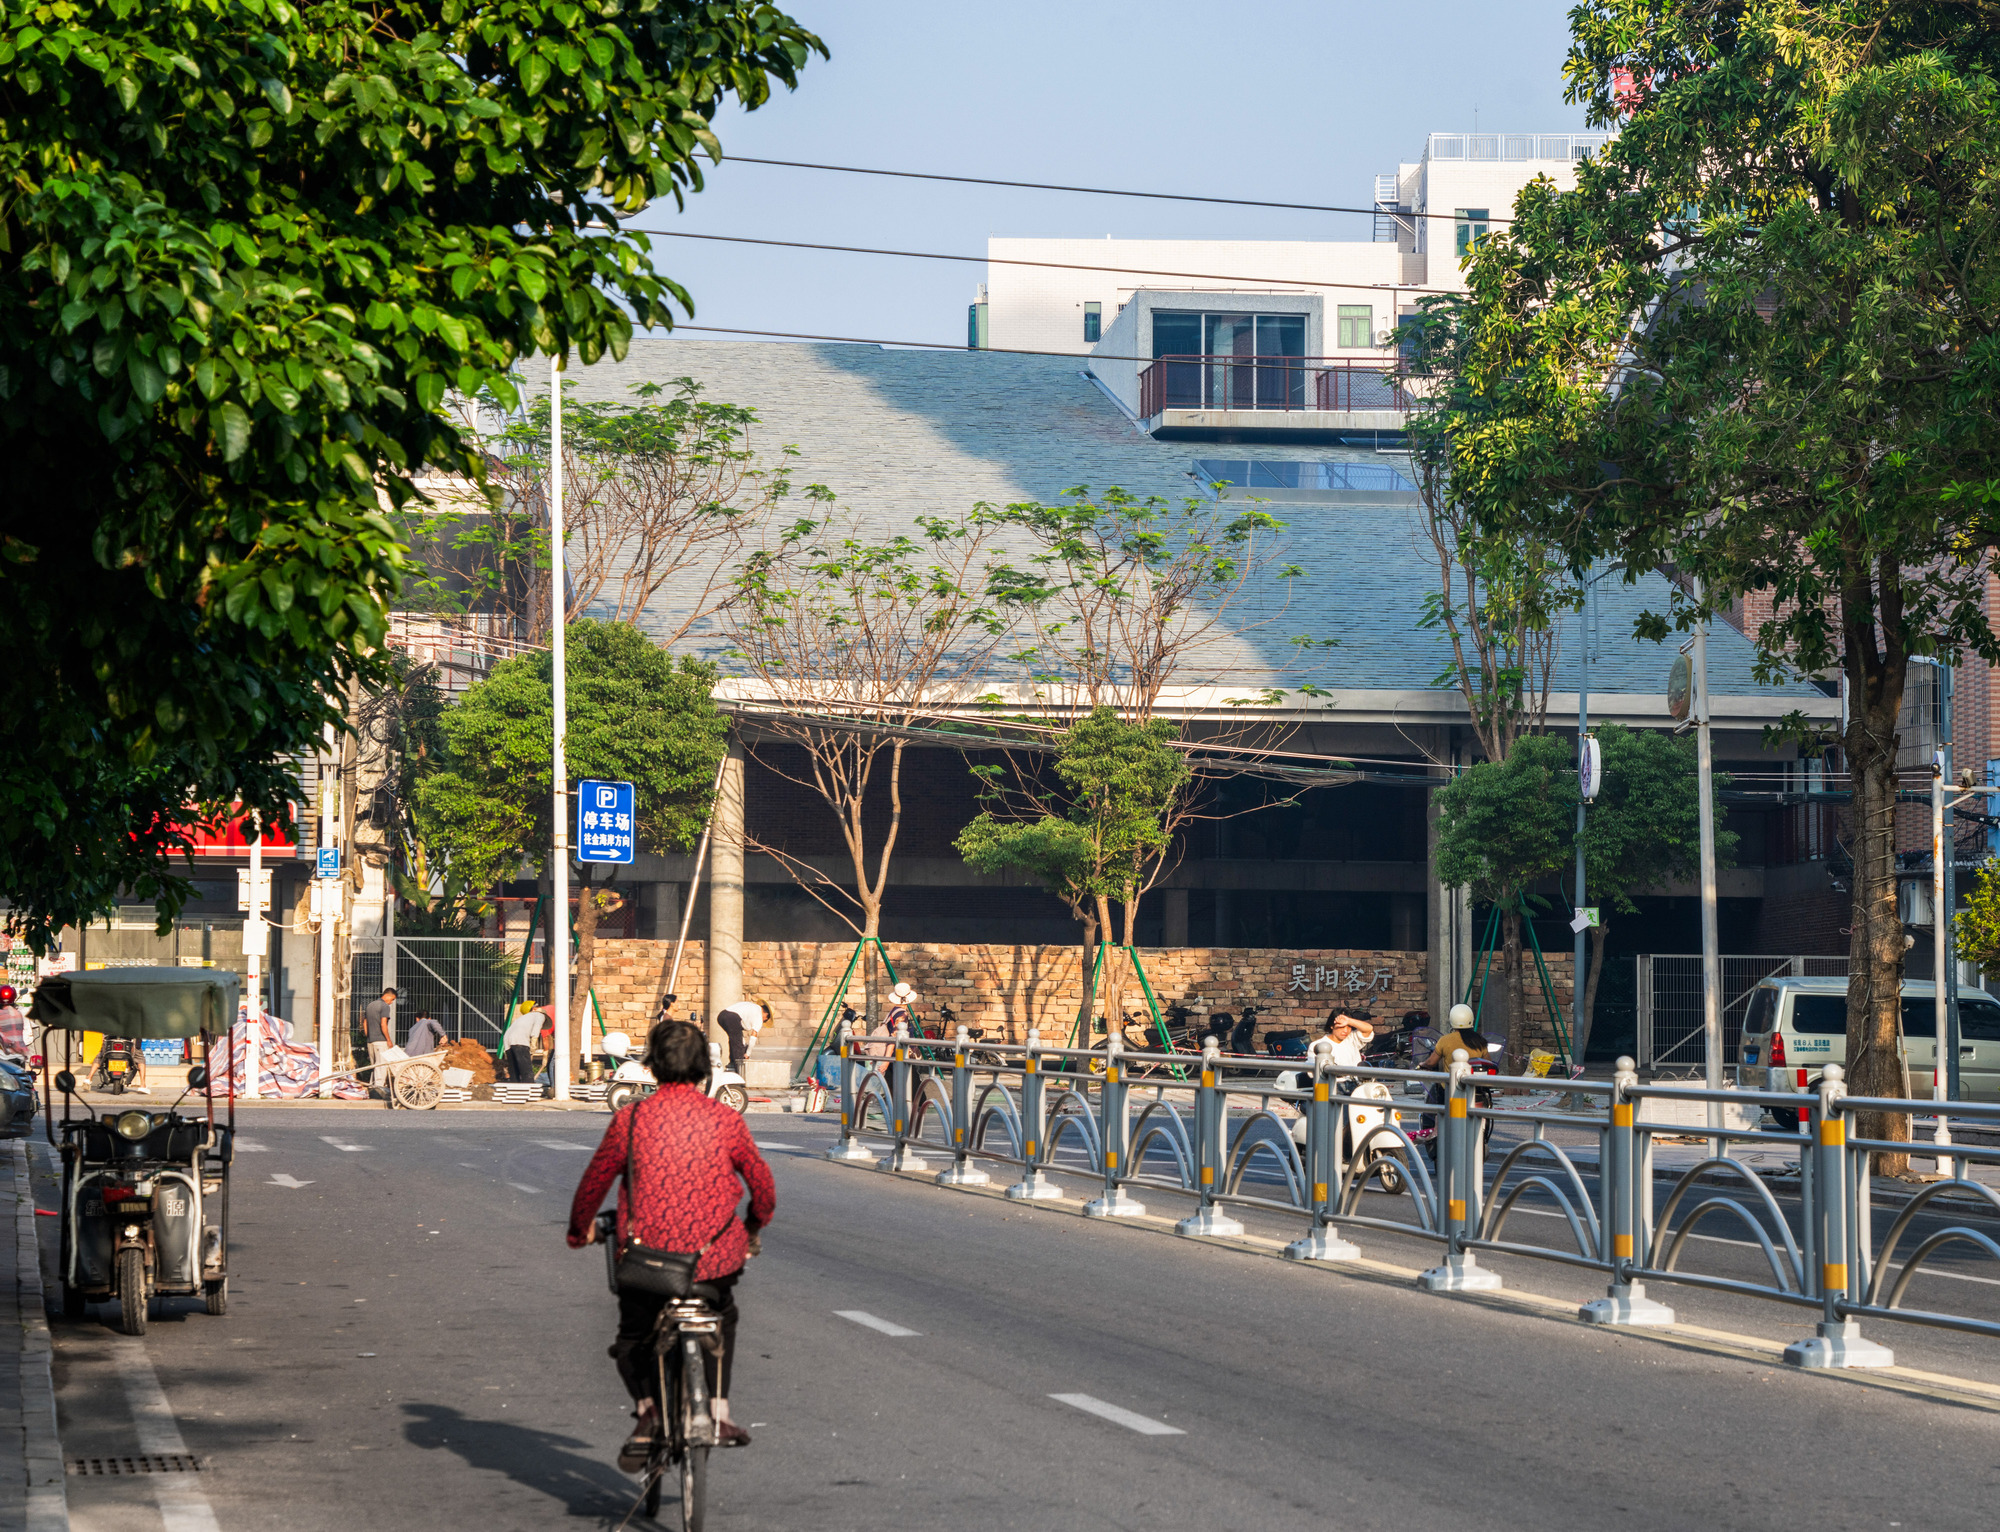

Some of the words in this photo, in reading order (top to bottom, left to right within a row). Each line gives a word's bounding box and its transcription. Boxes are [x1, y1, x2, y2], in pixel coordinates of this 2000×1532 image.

[601, 790, 614, 806] P
[583, 811, 630, 831] 停车场
[583, 833, 631, 848] 往金海岸方向
[1288, 964, 1393, 993] 吴阳客厅
[166, 1199, 185, 1217] 源
